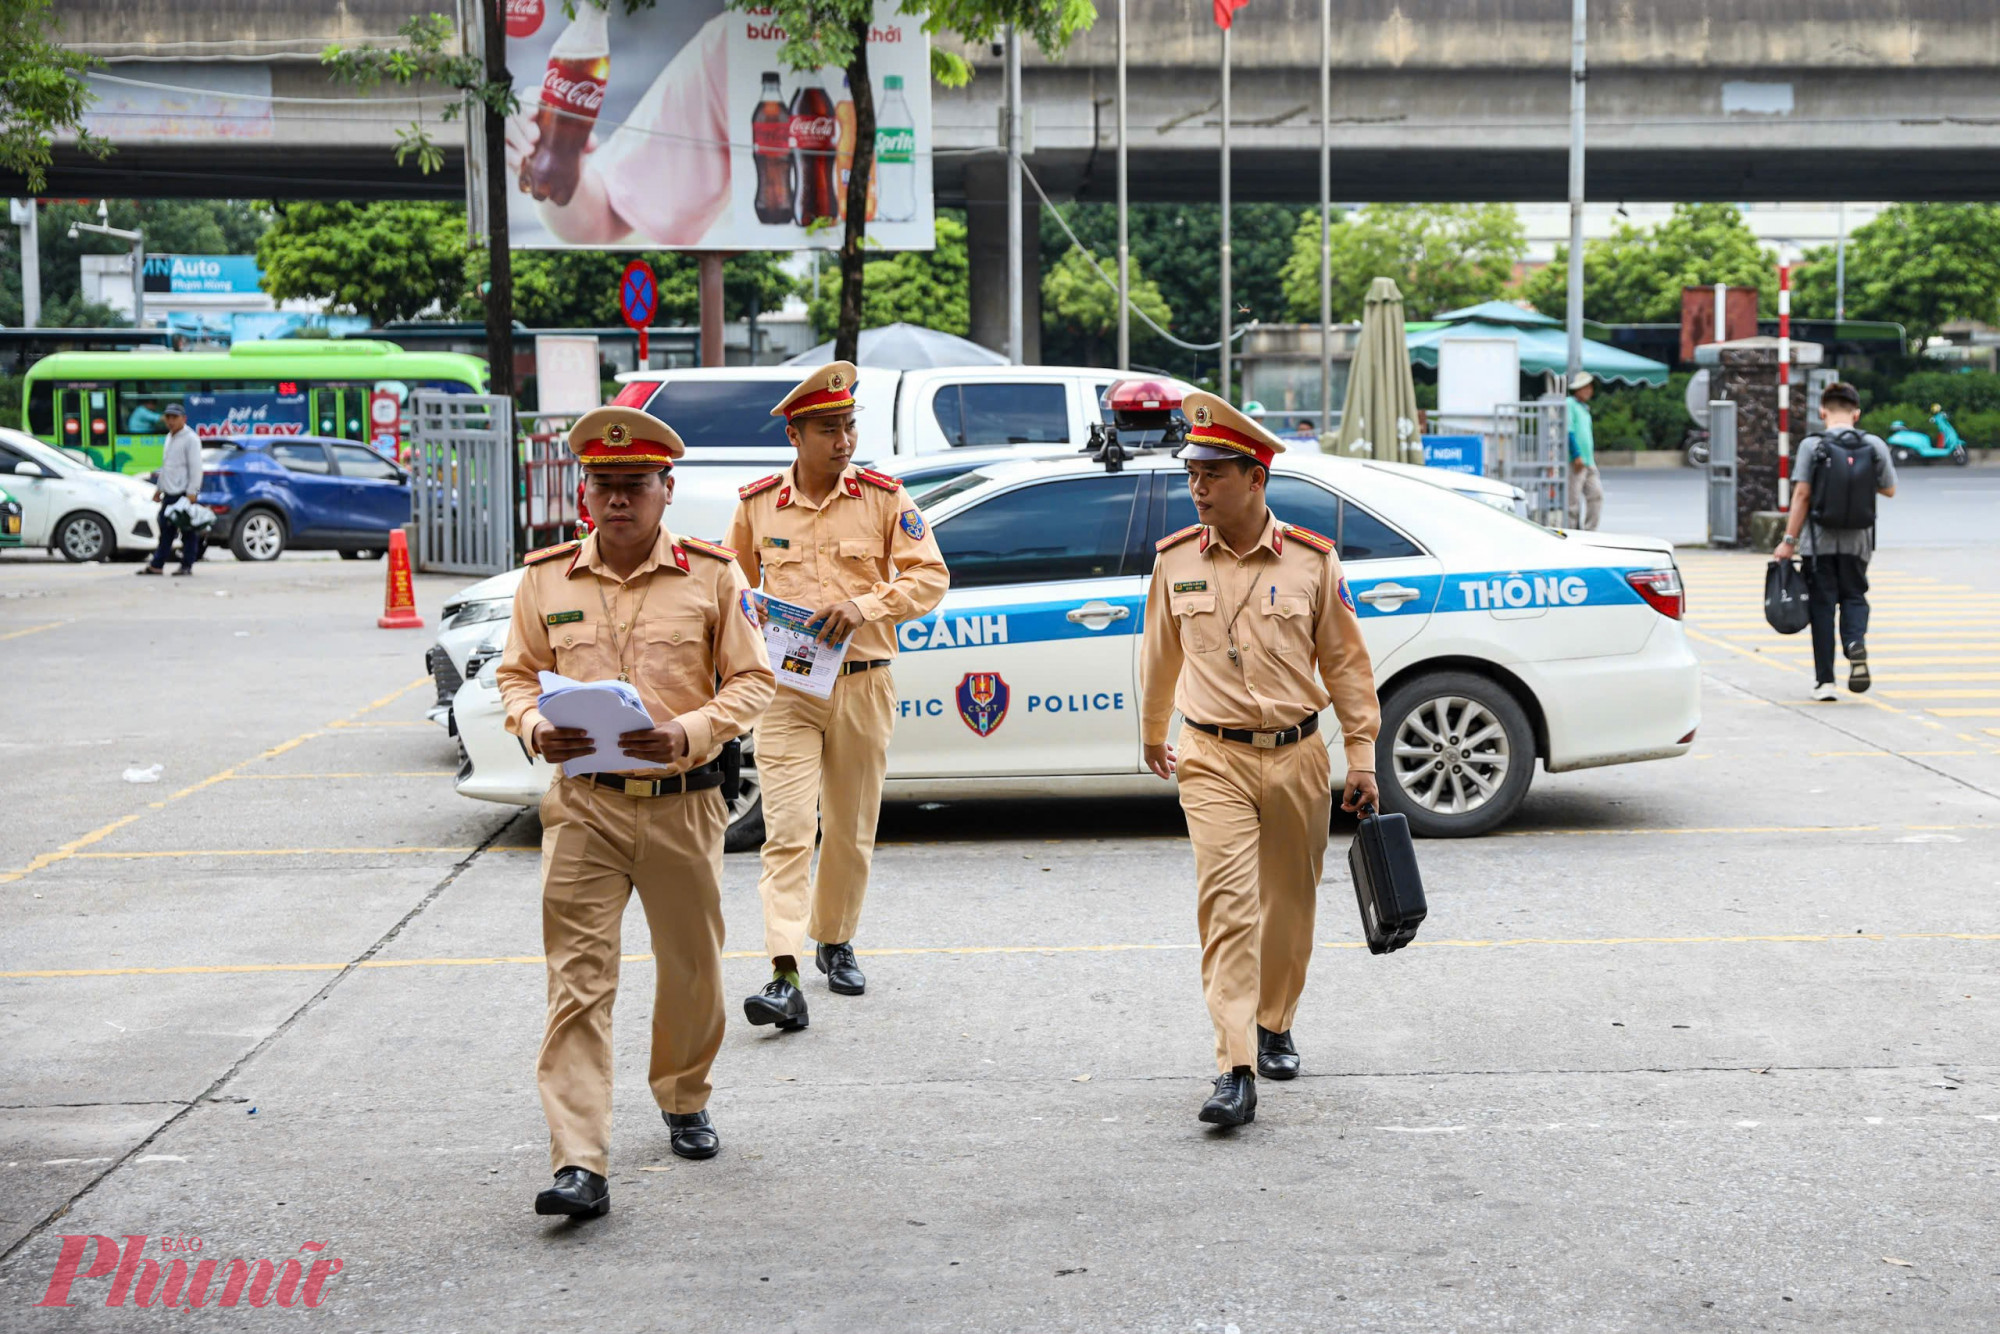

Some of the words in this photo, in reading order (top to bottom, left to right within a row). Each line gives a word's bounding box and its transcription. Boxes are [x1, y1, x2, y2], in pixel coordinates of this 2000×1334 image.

[172, 258, 220, 278] Auto
[898, 609, 1008, 650] CẢNH
[1458, 570, 1588, 609] THÔNG
[1027, 692, 1124, 713] POLICE
